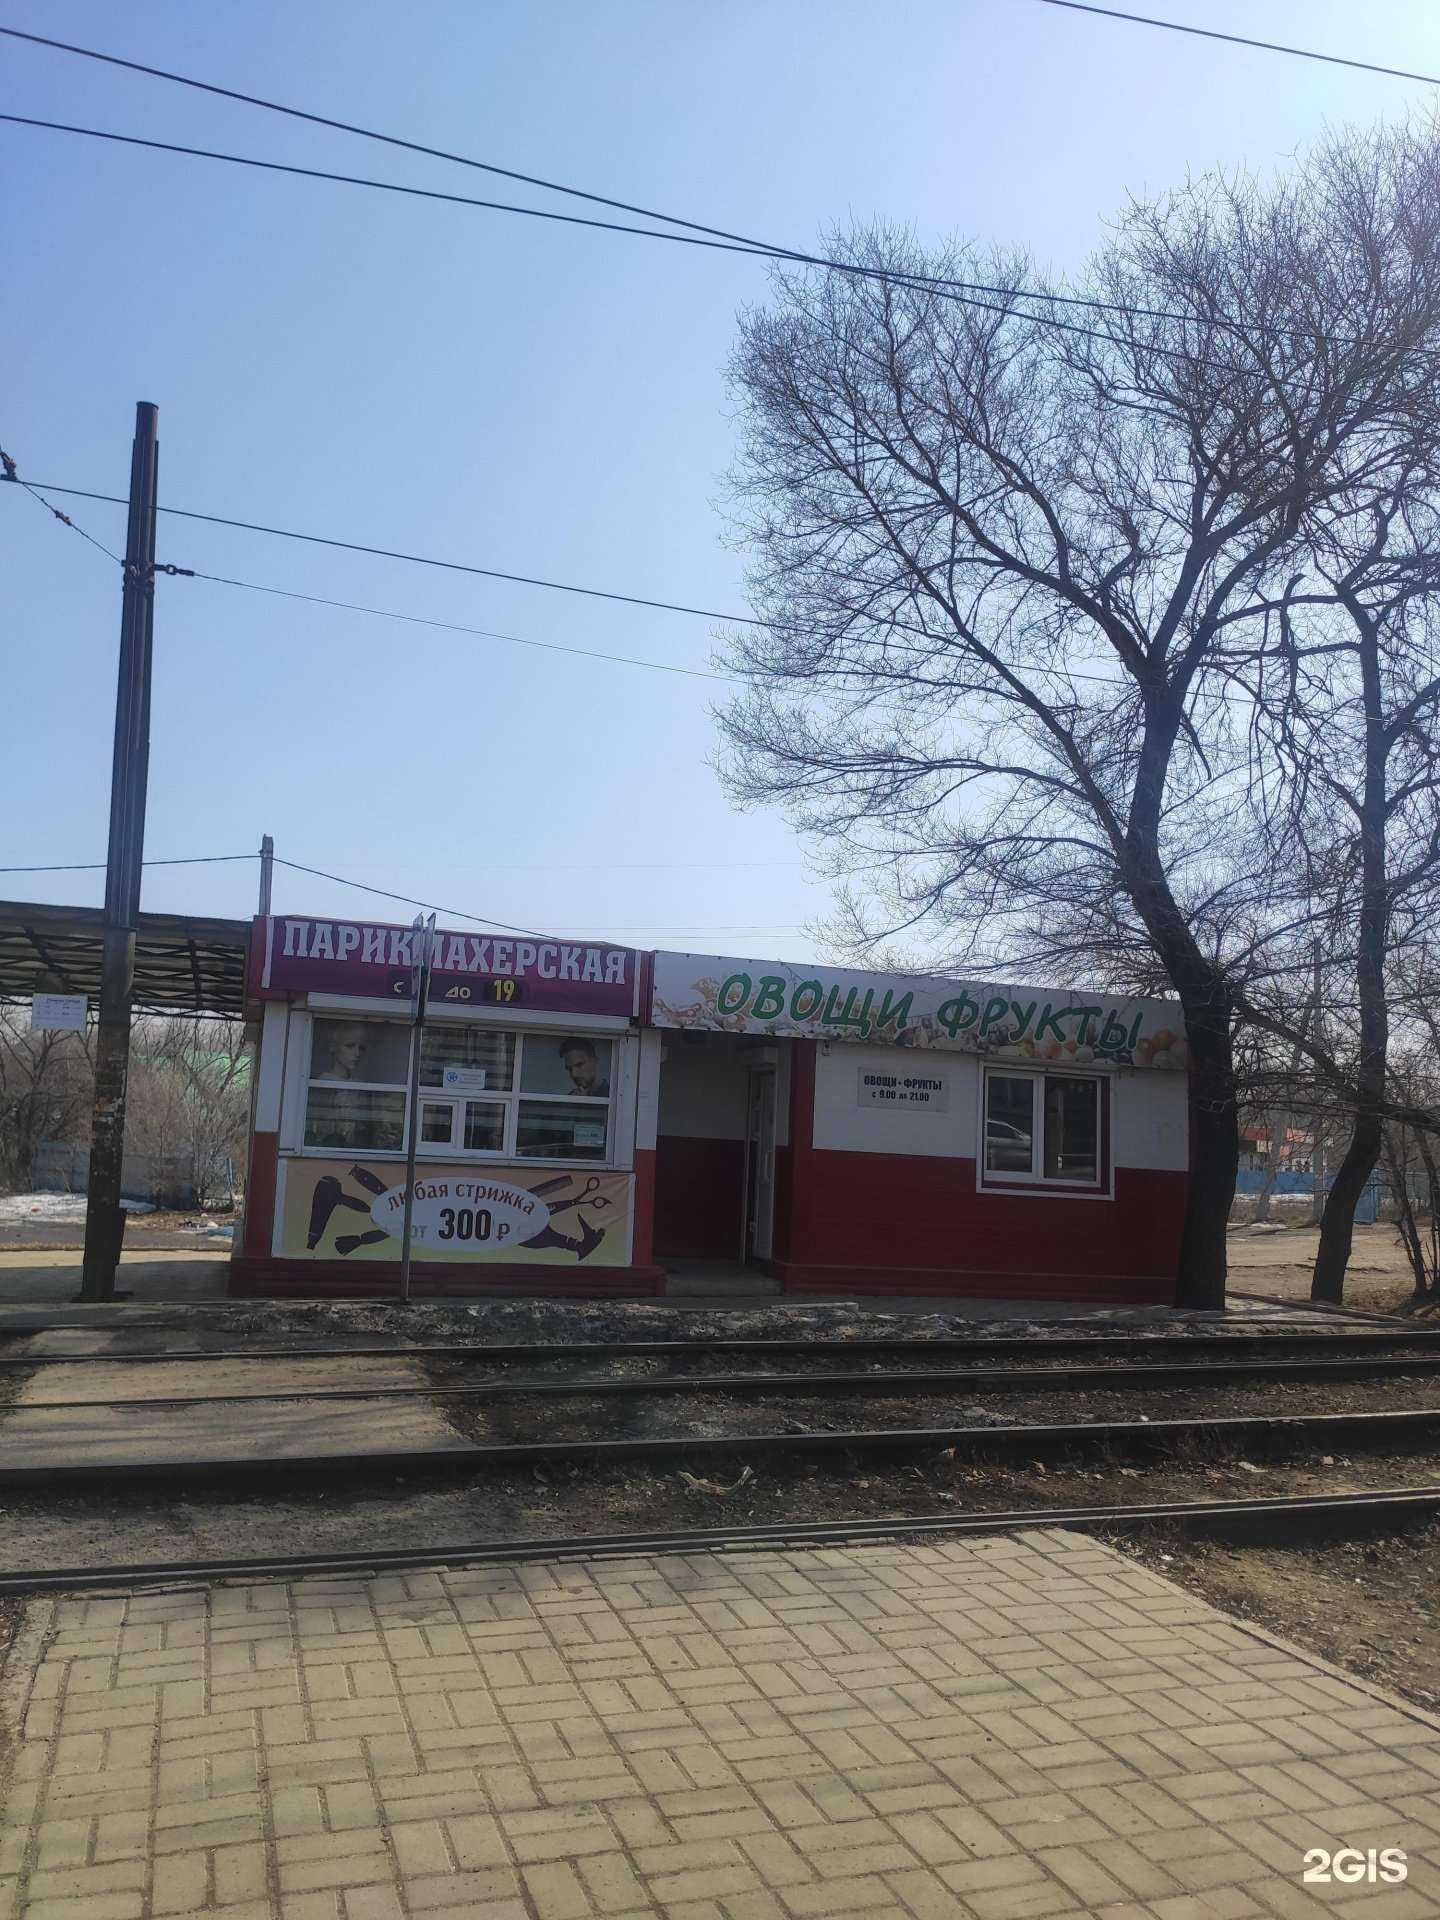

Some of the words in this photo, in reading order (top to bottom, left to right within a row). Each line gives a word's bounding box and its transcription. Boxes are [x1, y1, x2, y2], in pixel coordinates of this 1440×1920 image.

[494, 979, 515, 1001] 19
[715, 971, 914, 1040] ОВОЩИ
[937, 989, 1144, 1052] ФРУКТЫ
[864, 1075, 897, 1088] ОВОЩИ
[903, 1078, 942, 1091] ФРУКТЫ
[387, 1180, 449, 1211] лбая
[455, 1183, 536, 1216] стрижка
[438, 1207, 492, 1241] 300
